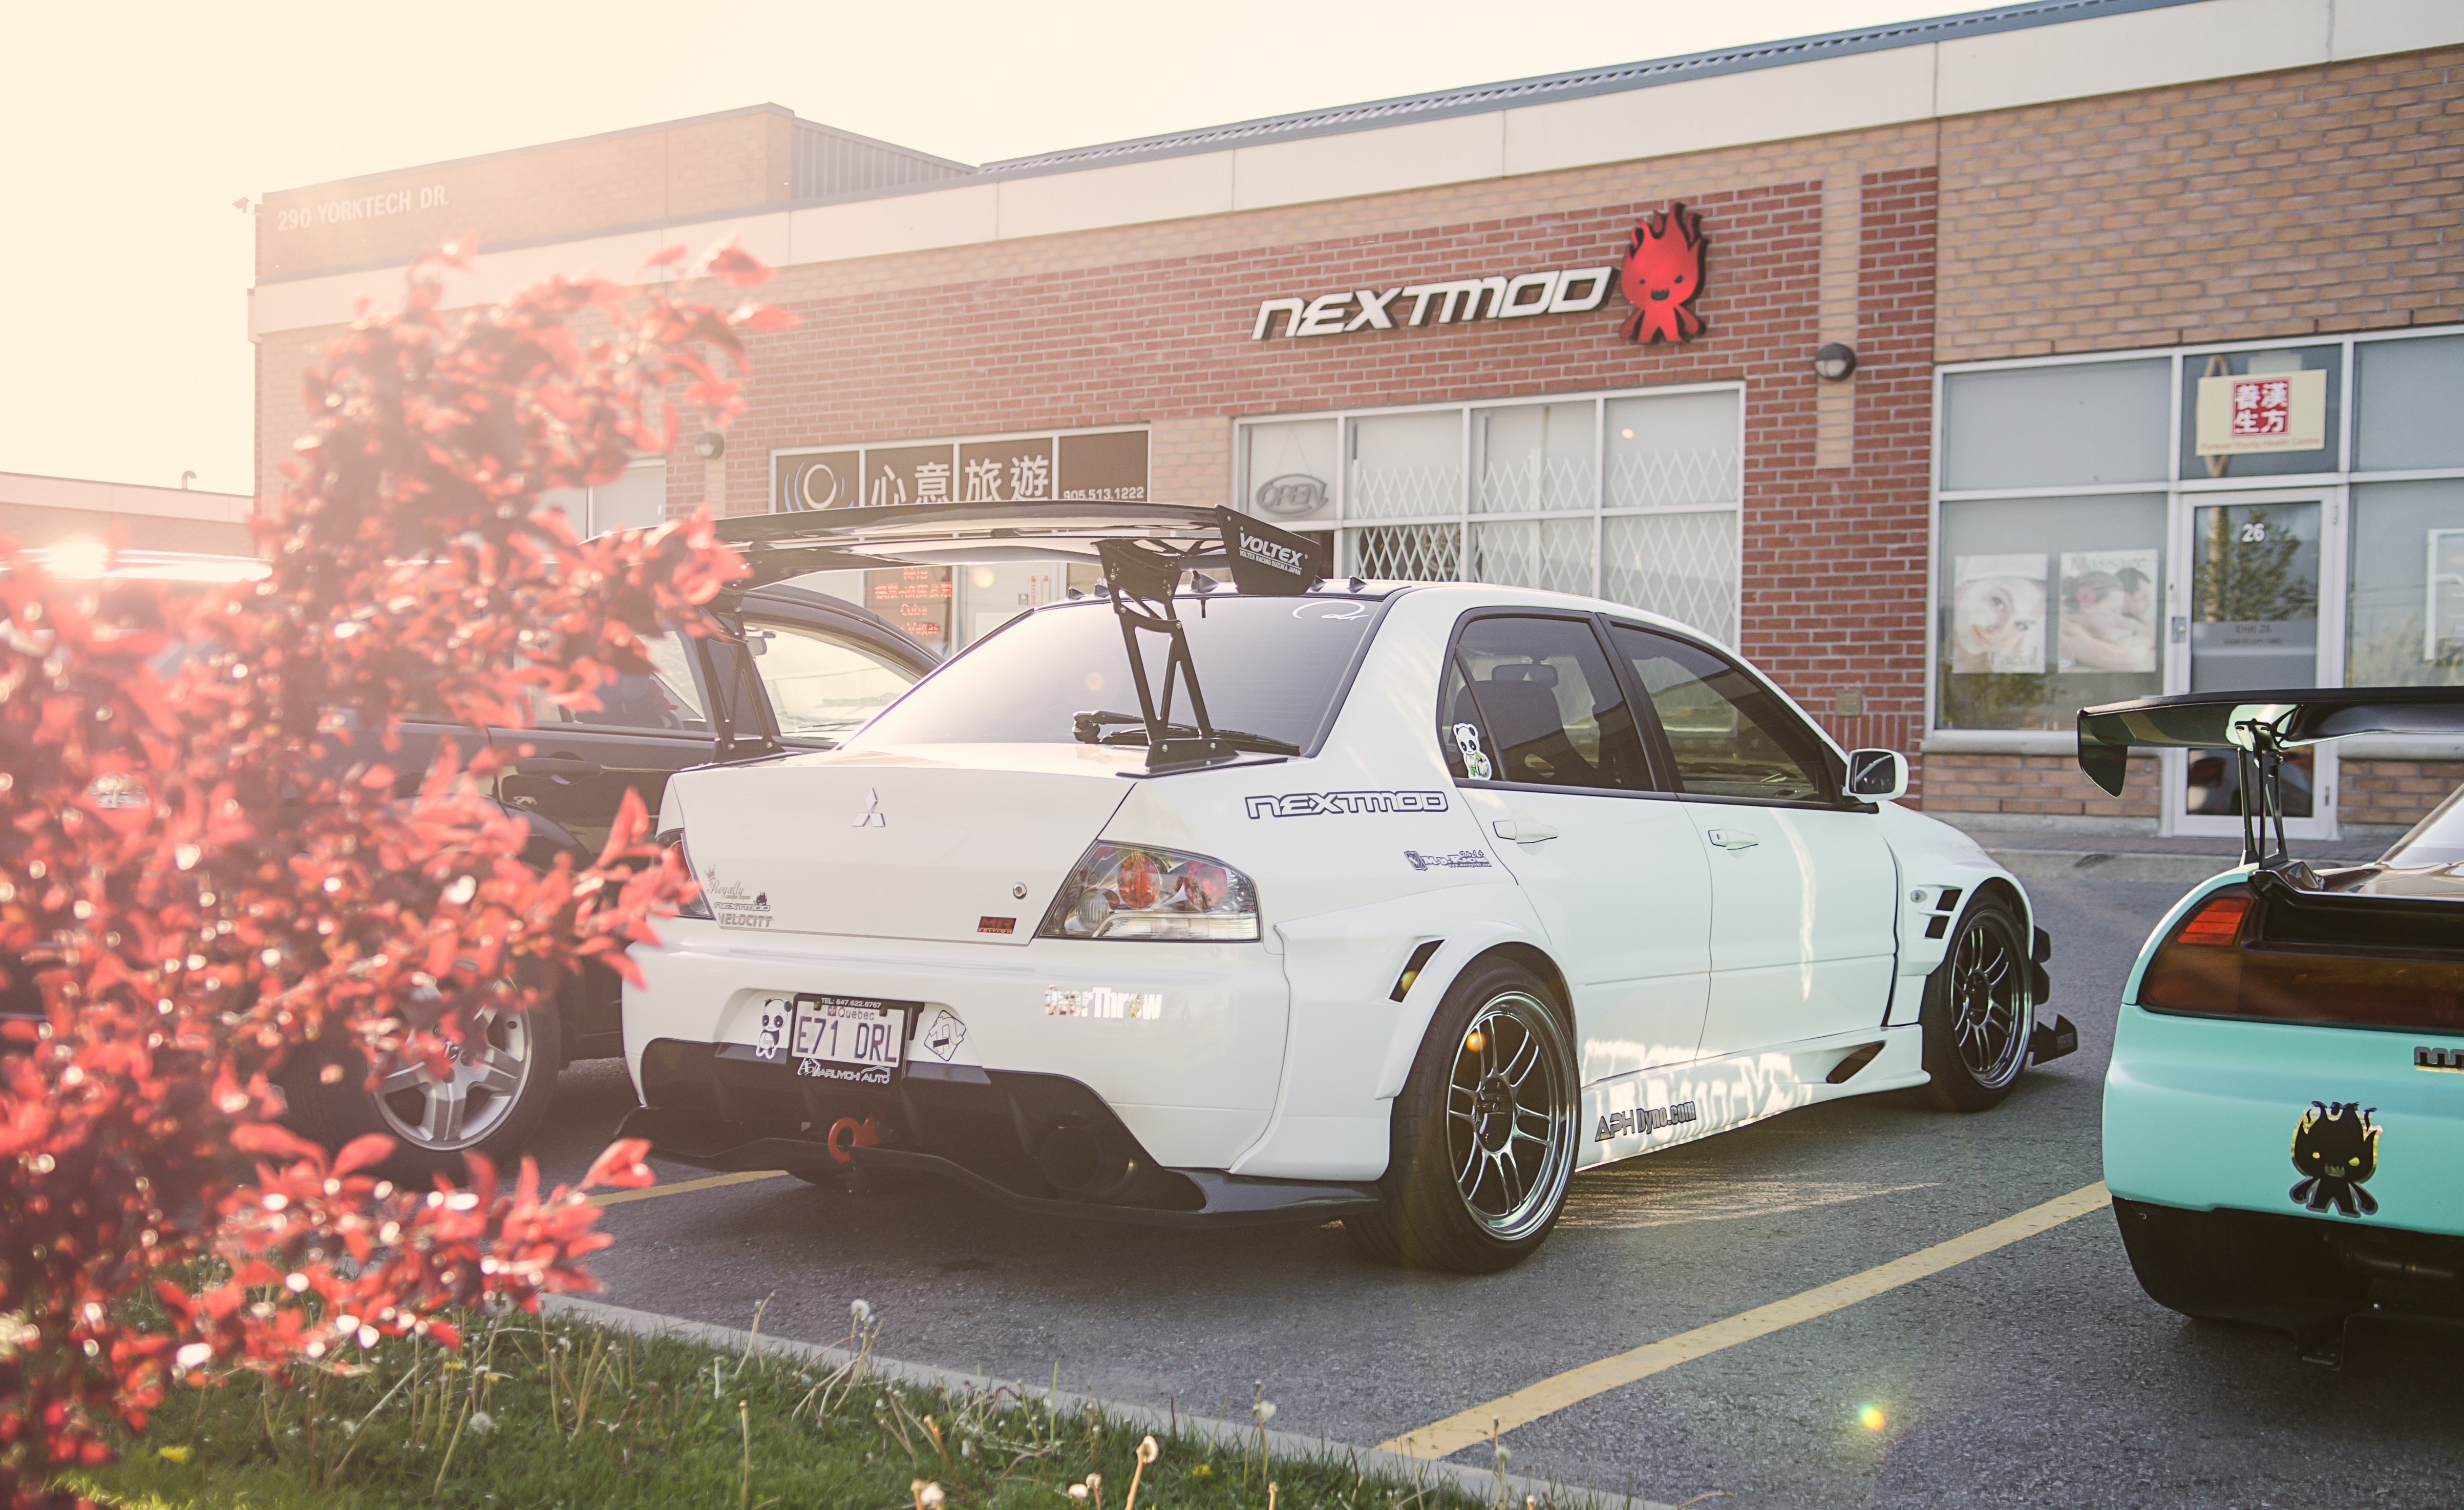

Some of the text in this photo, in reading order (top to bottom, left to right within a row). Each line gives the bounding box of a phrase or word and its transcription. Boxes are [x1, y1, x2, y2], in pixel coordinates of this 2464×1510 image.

[278, 184, 449, 232] 290 YORKTECH DR.
[1251, 266, 1613, 342] NEXTMOD
[1063, 486, 1144, 500] 905.513.1222
[1258, 484, 1327, 508] OPEN
[2241, 522, 2265, 542] 26
[1239, 532, 1303, 567] VOLTEX
[1239, 550, 1301, 576] VOLTEX RACING SUZUKA JAPAN
[1244, 790, 1449, 820] NEXTMOD
[707, 879, 745, 899] Royalty
[718, 913, 775, 928] VELOCITY
[980, 917, 1014, 929] MR
[836, 999, 882, 1009] 647.622.6767
[838, 1007, 875, 1020] Québec
[1044, 984, 1162, 1020] OverThrow
[796, 1016, 897, 1063] E71 DRL
[812, 1067, 890, 1084] MARUYICHI AUTO
[1595, 1101, 1696, 1142] APH Dyno.com
